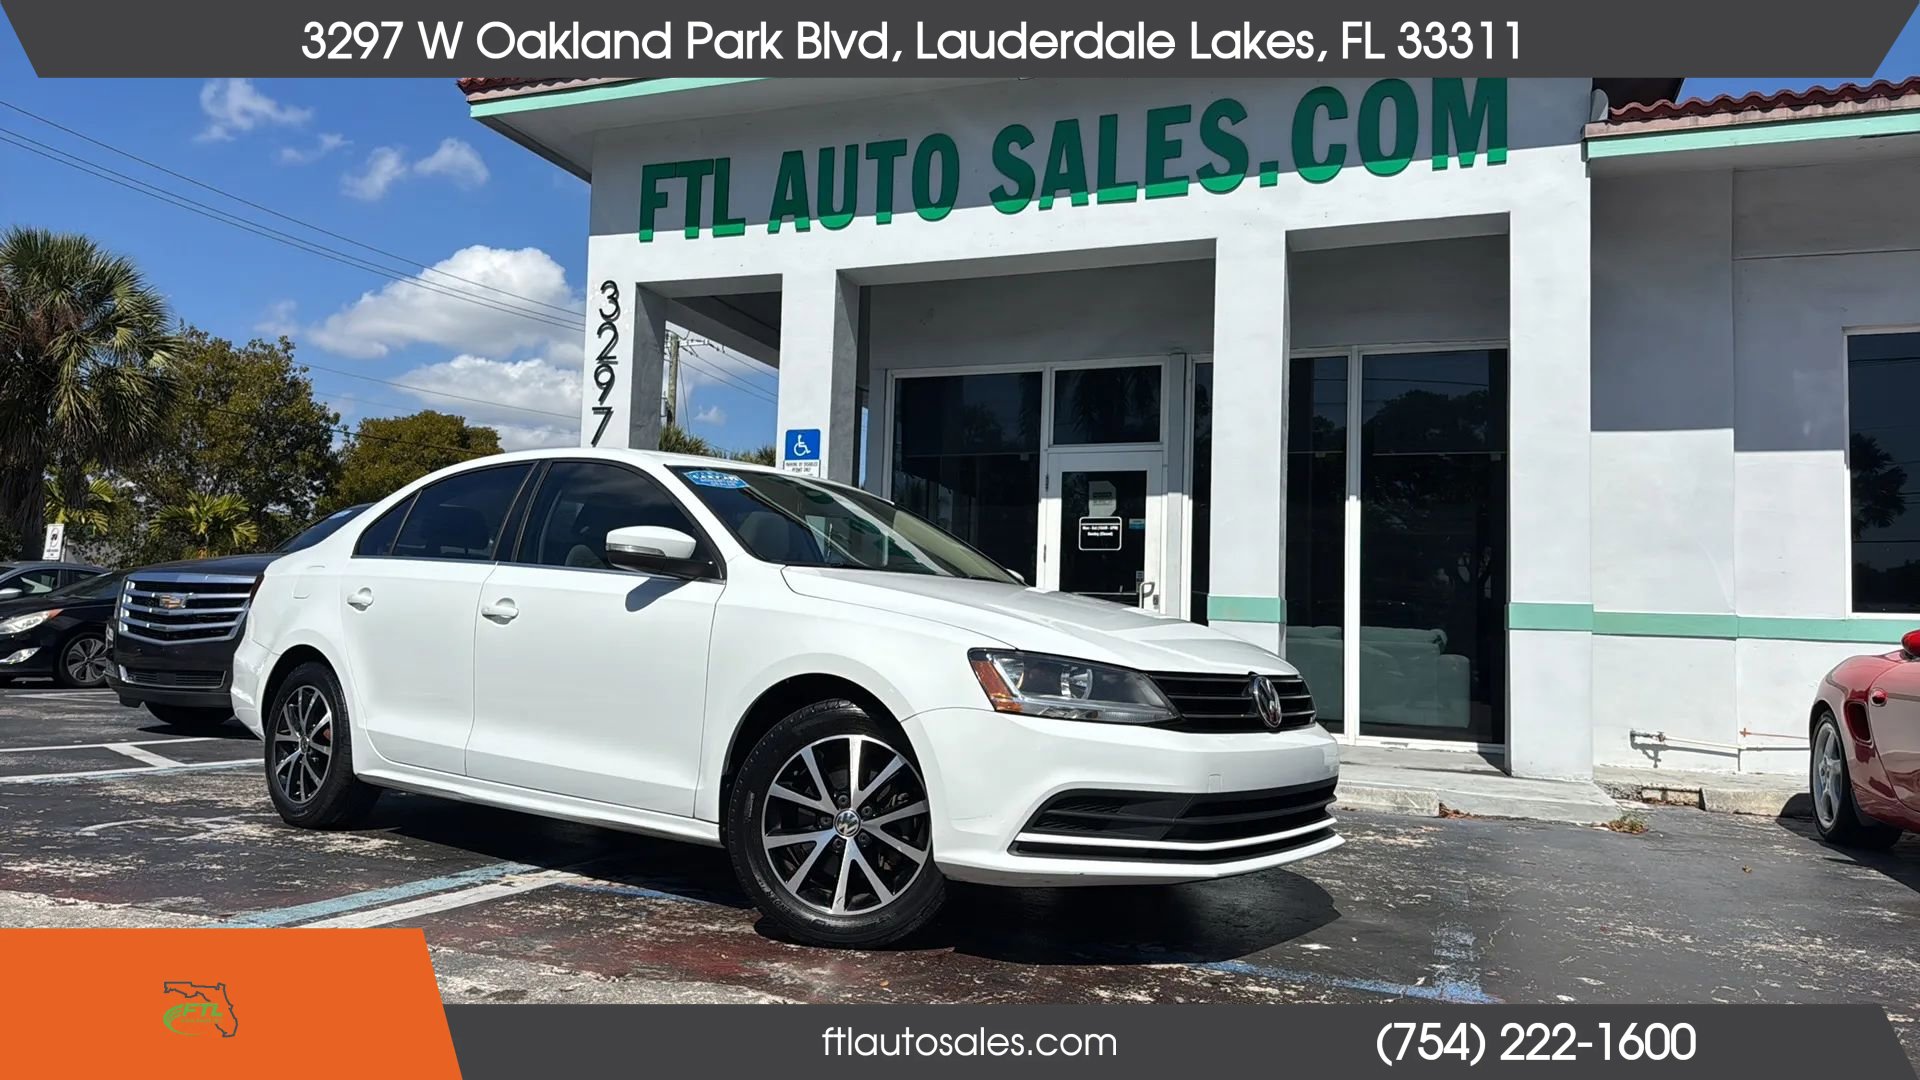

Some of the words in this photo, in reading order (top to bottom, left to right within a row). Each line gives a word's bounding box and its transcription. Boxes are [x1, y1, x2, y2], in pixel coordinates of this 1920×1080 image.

[638, 157, 747, 243] FTL
[767, 133, 960, 235] AUTO
[989, 77, 1509, 215] SALES.COM
[591, 280, 620, 447] 3297
